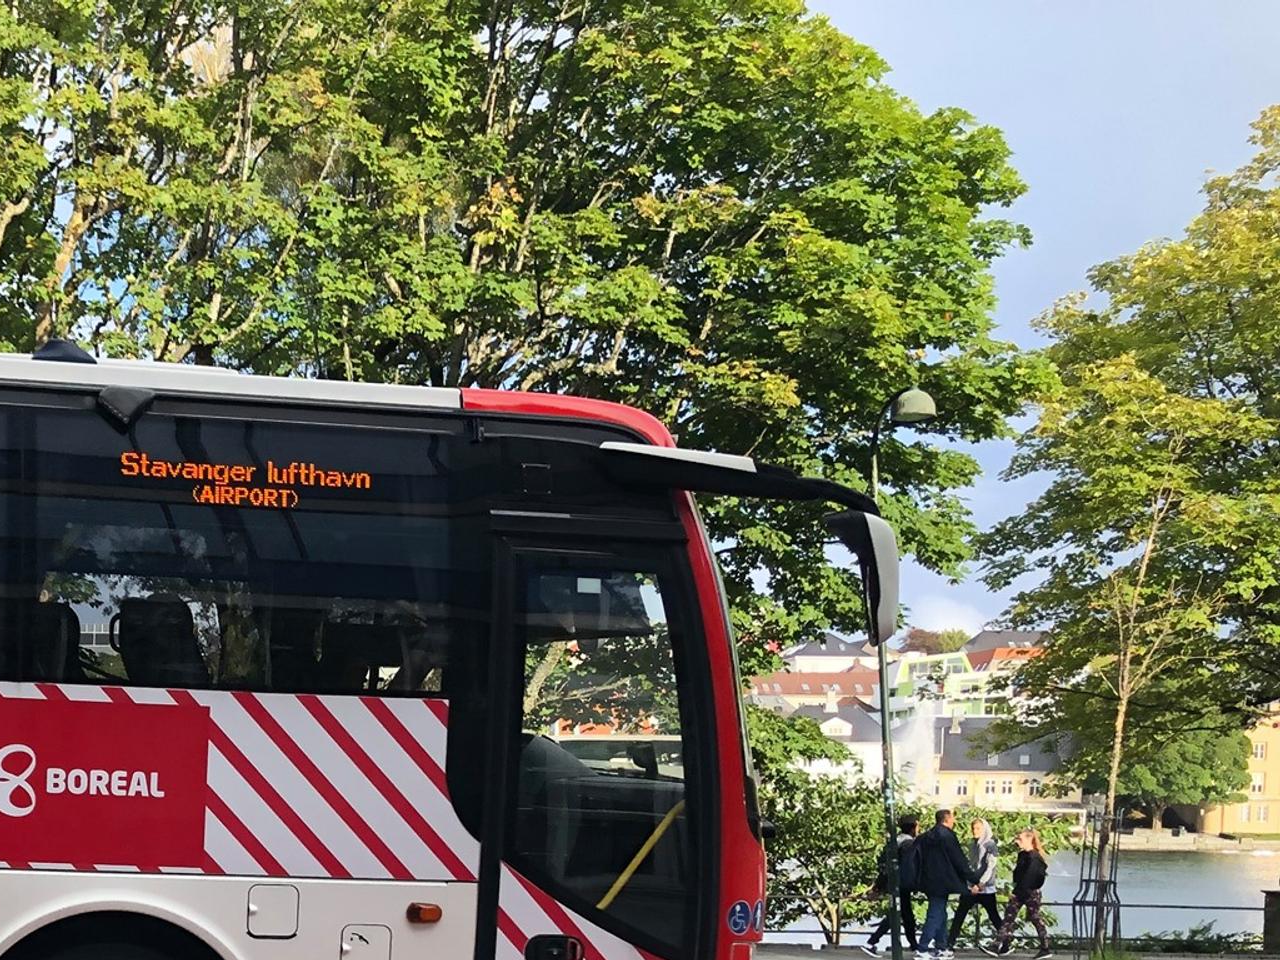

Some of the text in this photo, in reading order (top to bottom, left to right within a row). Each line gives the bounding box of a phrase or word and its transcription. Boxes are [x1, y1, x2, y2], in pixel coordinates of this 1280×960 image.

[120, 452, 371, 489] Stavanger lufthavn
[192, 485, 298, 509] (AIRPORT)
[46, 767, 165, 798] BOREAL
